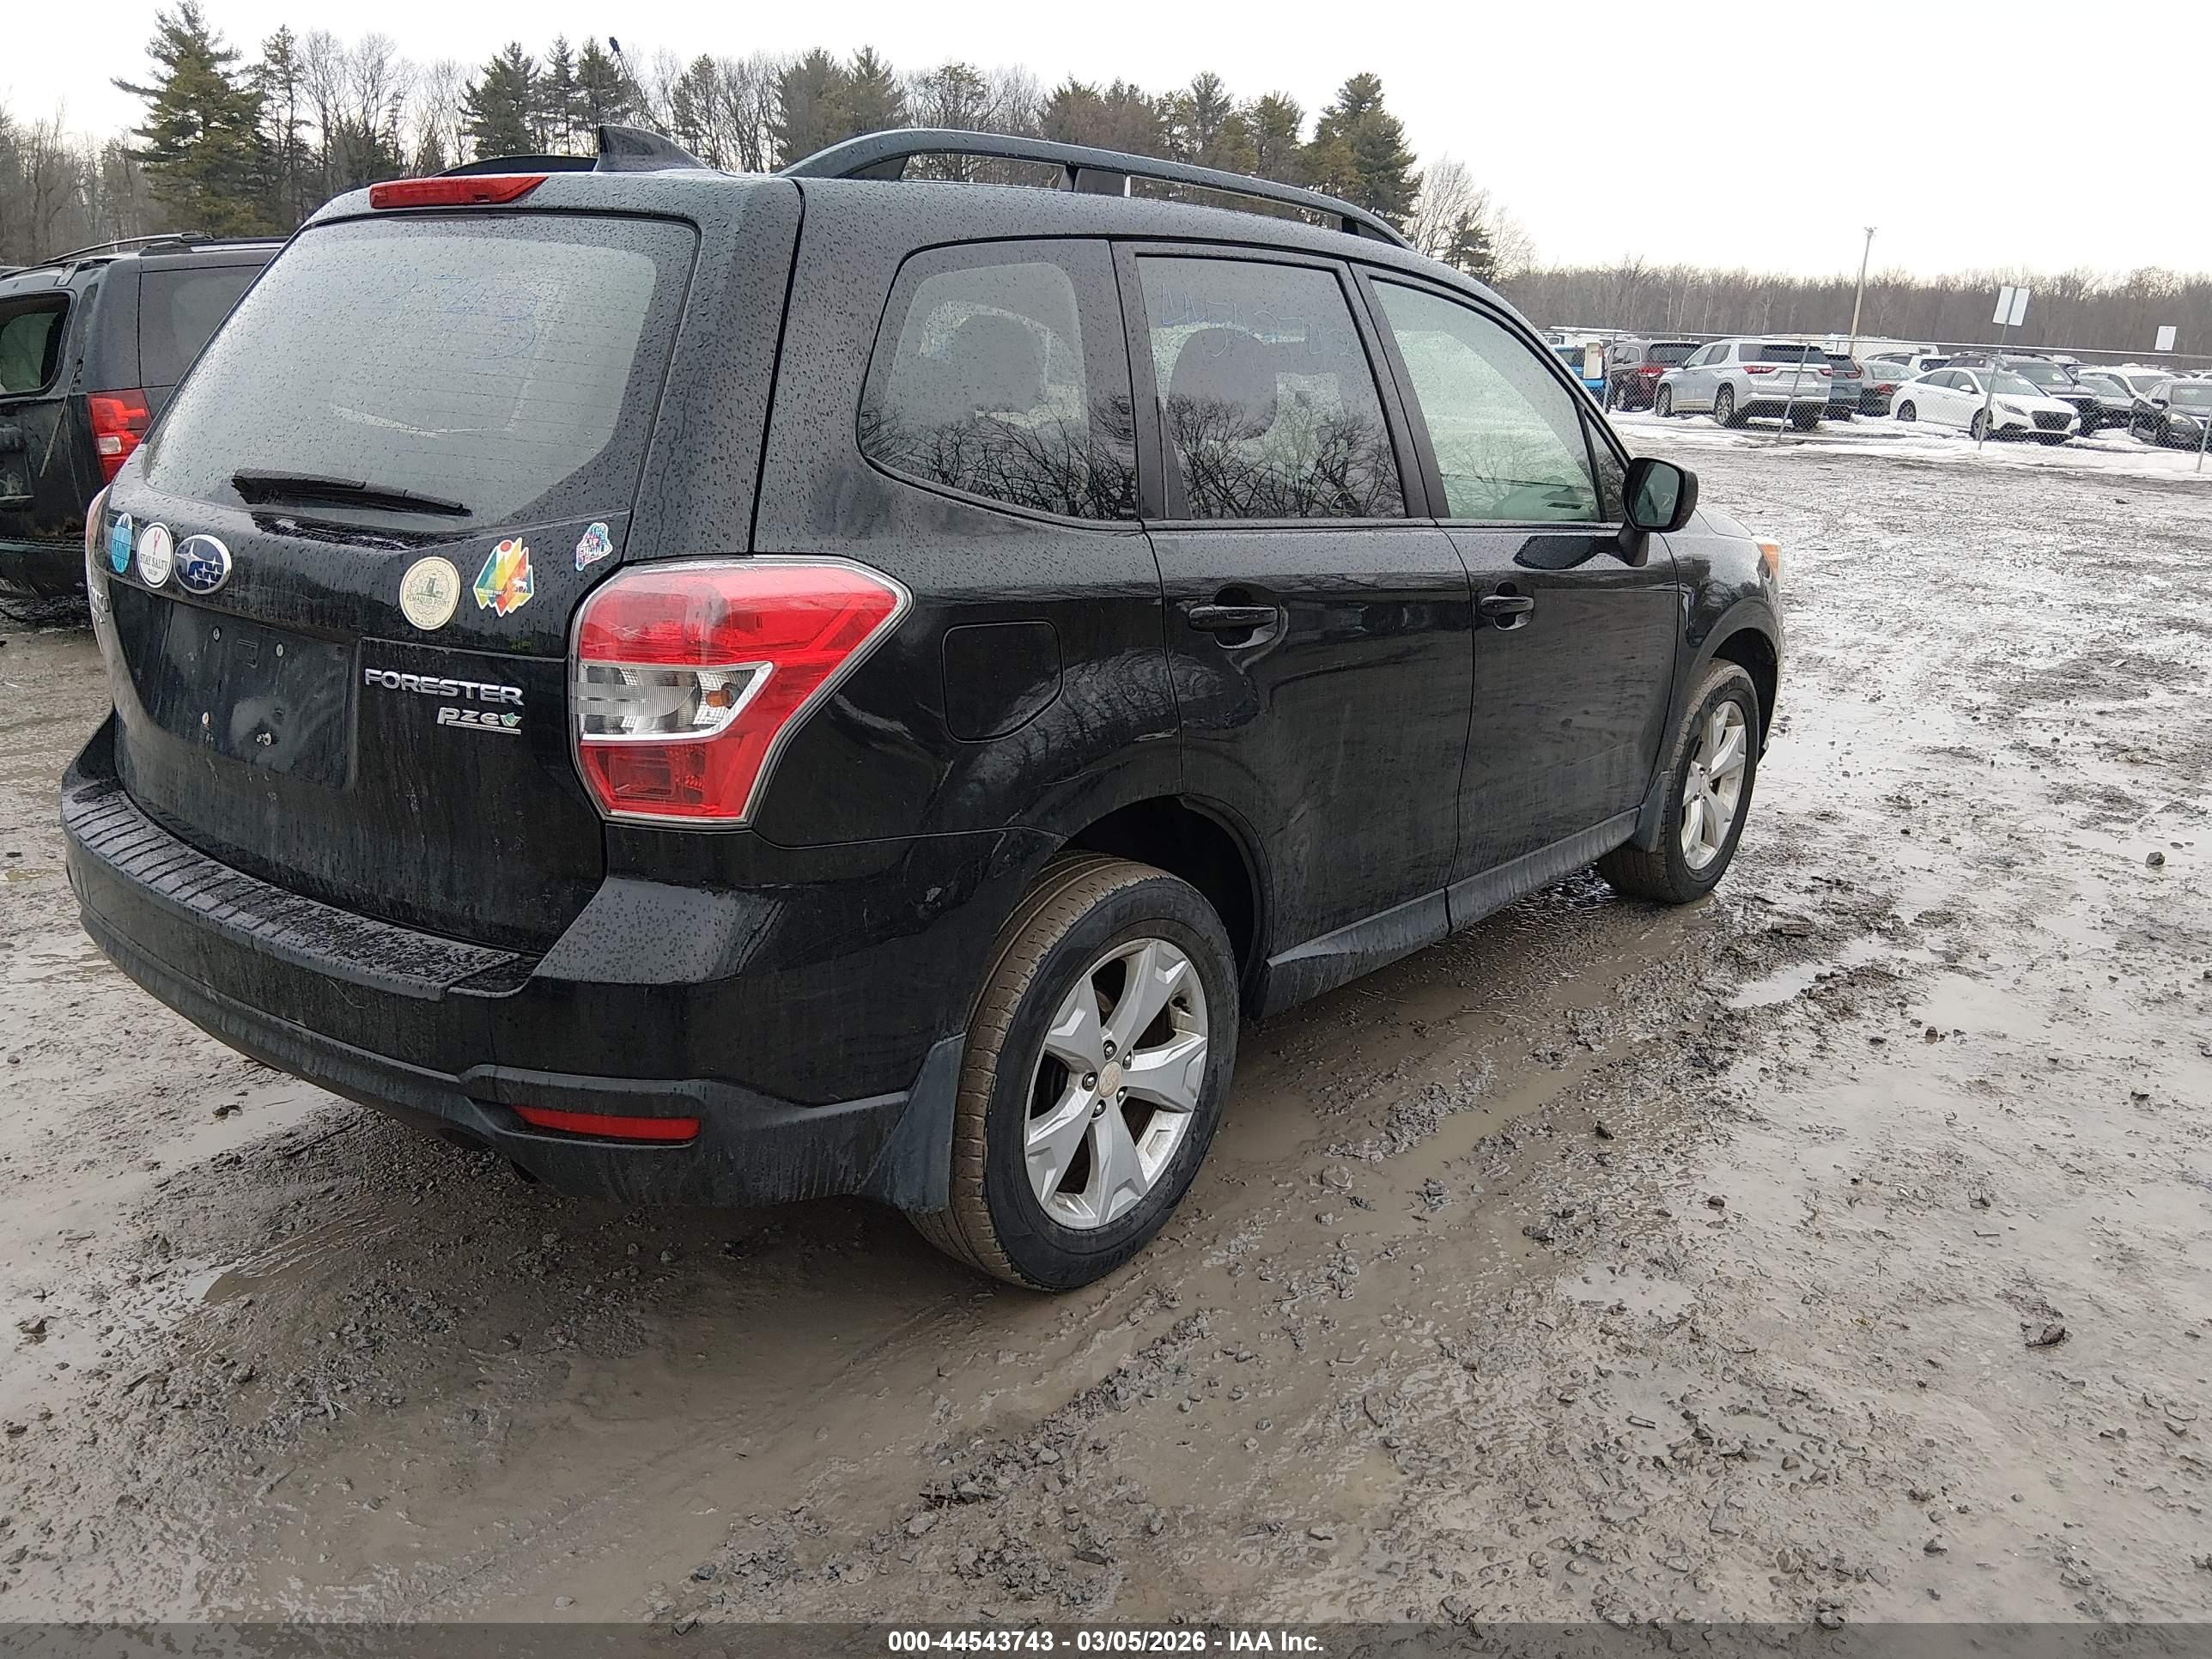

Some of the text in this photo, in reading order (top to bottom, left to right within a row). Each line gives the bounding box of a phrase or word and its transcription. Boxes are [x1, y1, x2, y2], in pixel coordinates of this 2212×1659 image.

[140, 553, 152, 566] STAY
[152, 557, 169, 571] SALTY
[405, 593, 451, 608] PEMAQUID POINT
[364, 668, 525, 706] FORESTER
